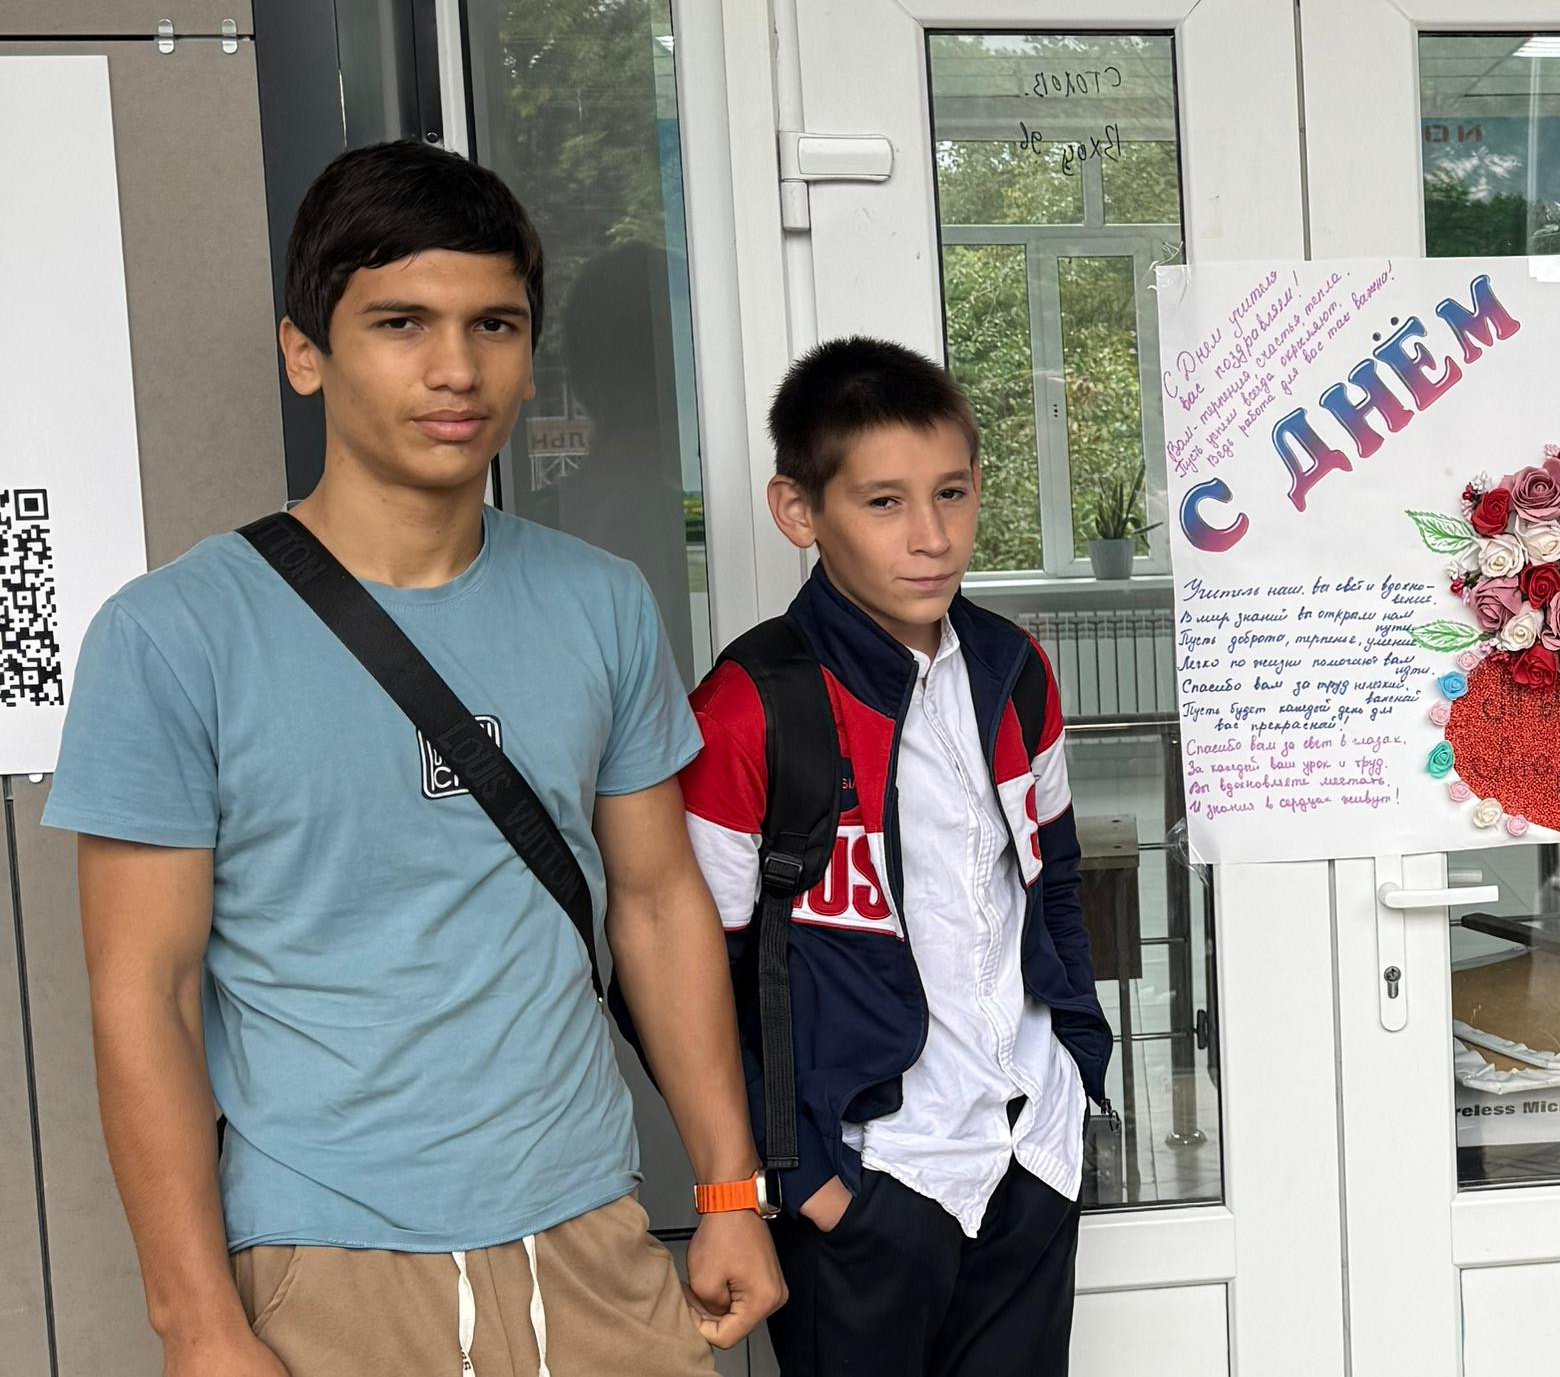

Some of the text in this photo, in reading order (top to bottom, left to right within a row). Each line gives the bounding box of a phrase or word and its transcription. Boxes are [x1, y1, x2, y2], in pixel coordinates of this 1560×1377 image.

[1164, 271, 1278, 398] С учителя
[1180, 271, 1302, 411] вас поздравляем!
[1207, 313, 1350, 467] Ведь работа для вас так
[1175, 445, 1203, 478] Пусть
[1206, 408, 1237, 448] успехи
[1241, 373, 1275, 406] всегда
[1180, 478, 1249, 552] С
[1273, 275, 1520, 512] ДНЁМ
[1183, 578, 1260, 601] Учитель
[1197, 612, 1230, 629] мир
[1234, 608, 1288, 628] знаний
[1298, 606, 1312, 621] вы
[1318, 608, 1376, 625] открыли
[1382, 610, 1414, 621] нам
[1179, 628, 1216, 652] Пусть
[1177, 652, 1415, 674] Легко по жизни помогают вам
[1182, 676, 1349, 696] Спасибо вам за труд
[1182, 701, 1220, 722] Пусть
[1231, 702, 1266, 720] будет
[1338, 706, 1363, 720] день
[1370, 706, 1392, 721] для
[1214, 718, 1239, 731] вас
[1186, 738, 1241, 756] Спасибо
[1250, 735, 1276, 751] вам
[1281, 740, 1295, 757] за
[1303, 736, 1332, 749] свет
[1341, 733, 1347, 747] в
[1188, 760, 1204, 776] За
[1271, 757, 1295, 770] ваш
[1303, 760, 1331, 776] урок
[1189, 781, 1210, 794] Вы
[1220, 775, 1309, 798] вдохновляете
[1206, 803, 1254, 820] знания
[1265, 796, 1273, 809] в
[1280, 797, 1331, 813] сердцах
[792, 834, 892, 920] US
